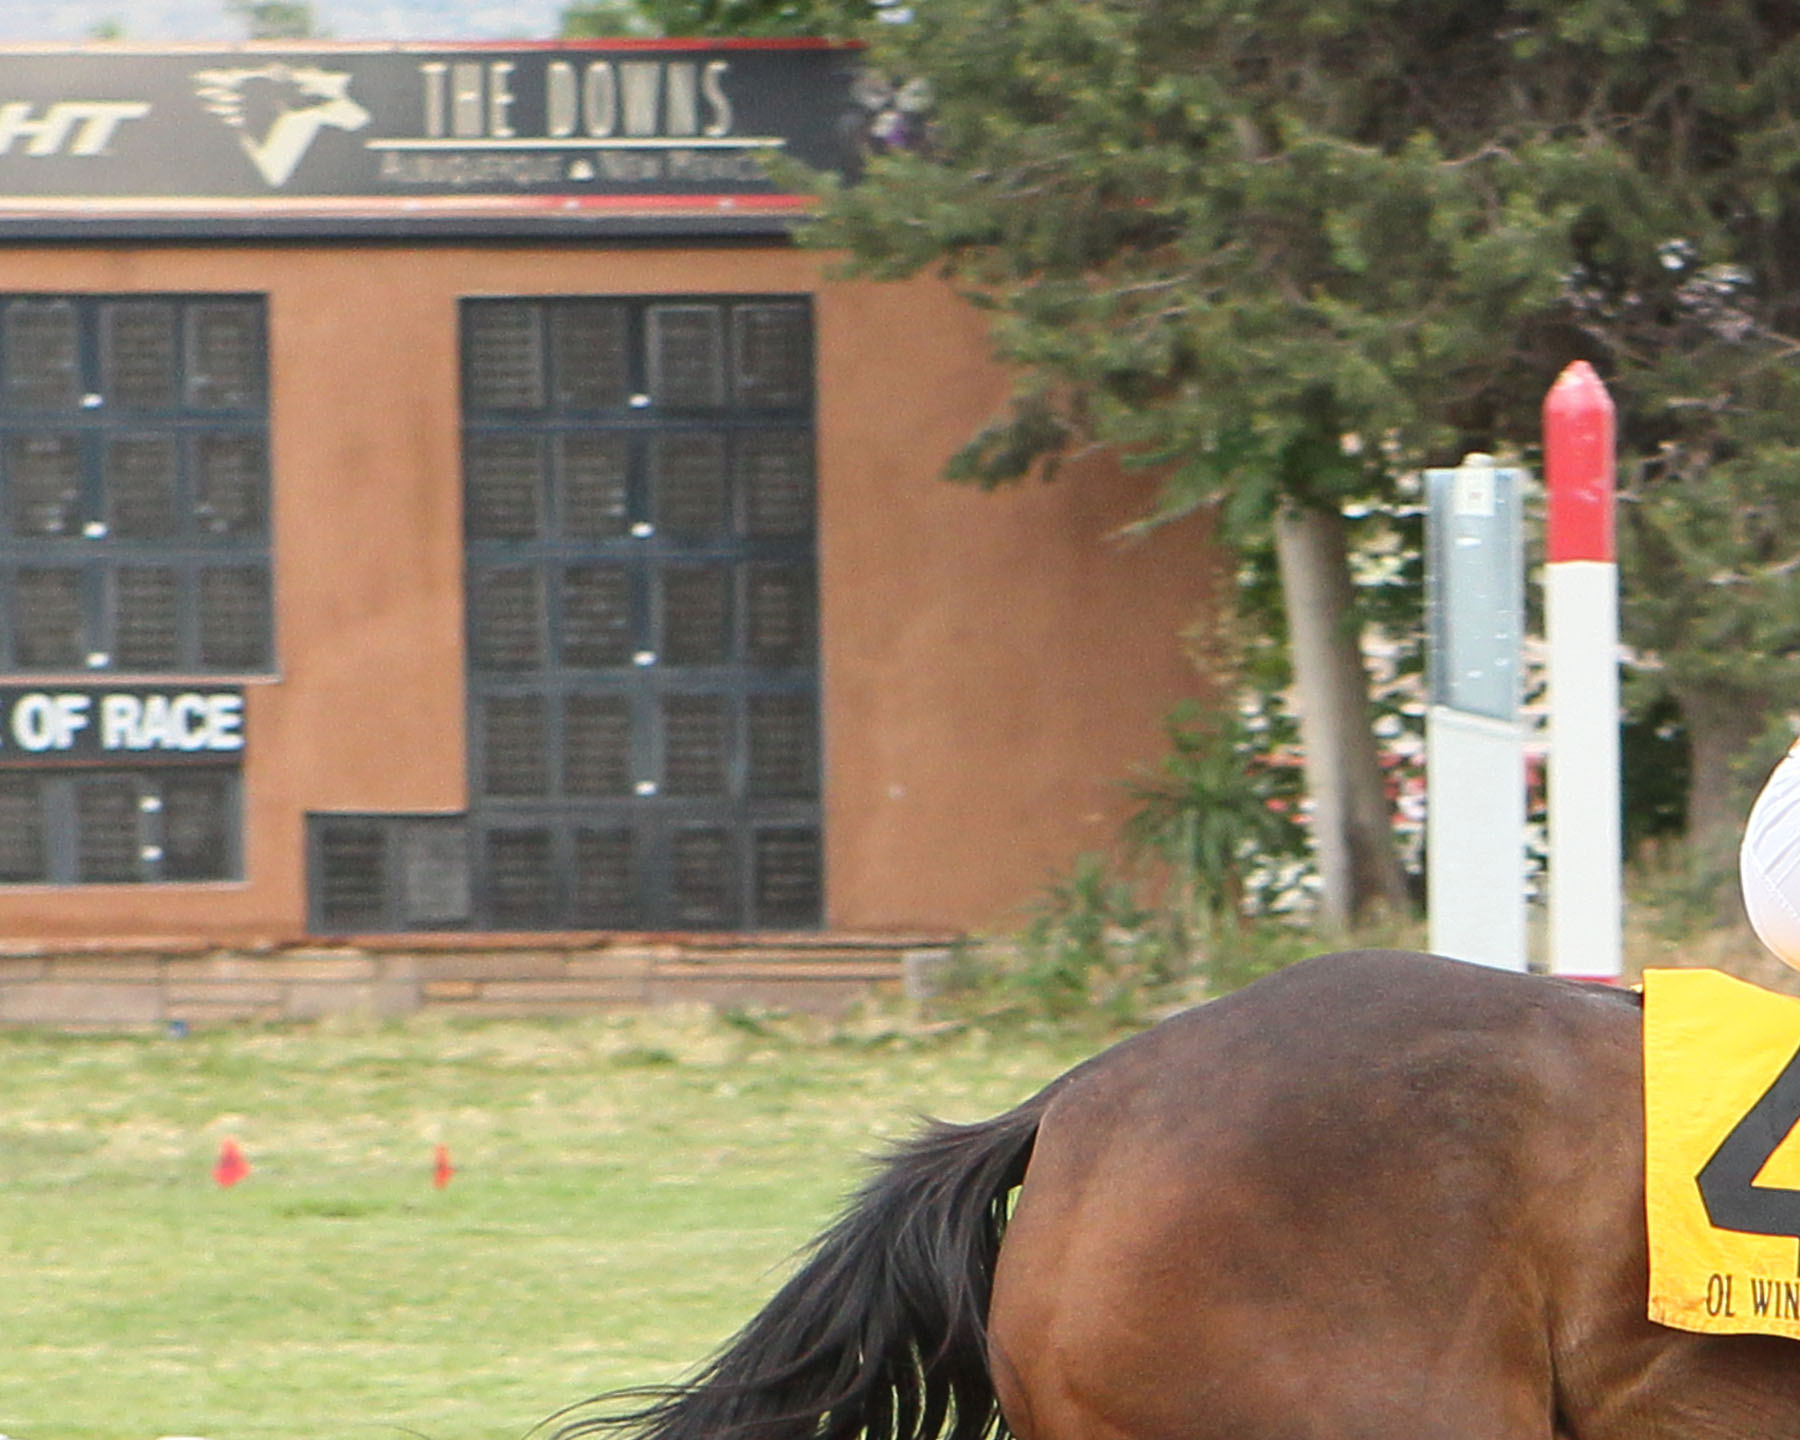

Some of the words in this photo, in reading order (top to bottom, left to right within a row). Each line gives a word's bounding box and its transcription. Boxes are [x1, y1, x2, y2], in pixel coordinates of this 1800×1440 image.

[419, 61, 516, 137] THE
[546, 61, 734, 137] DOWNS
[12, 693, 91, 751] OF
[102, 693, 244, 751] RACE
[1706, 1273, 1735, 1318] OL
